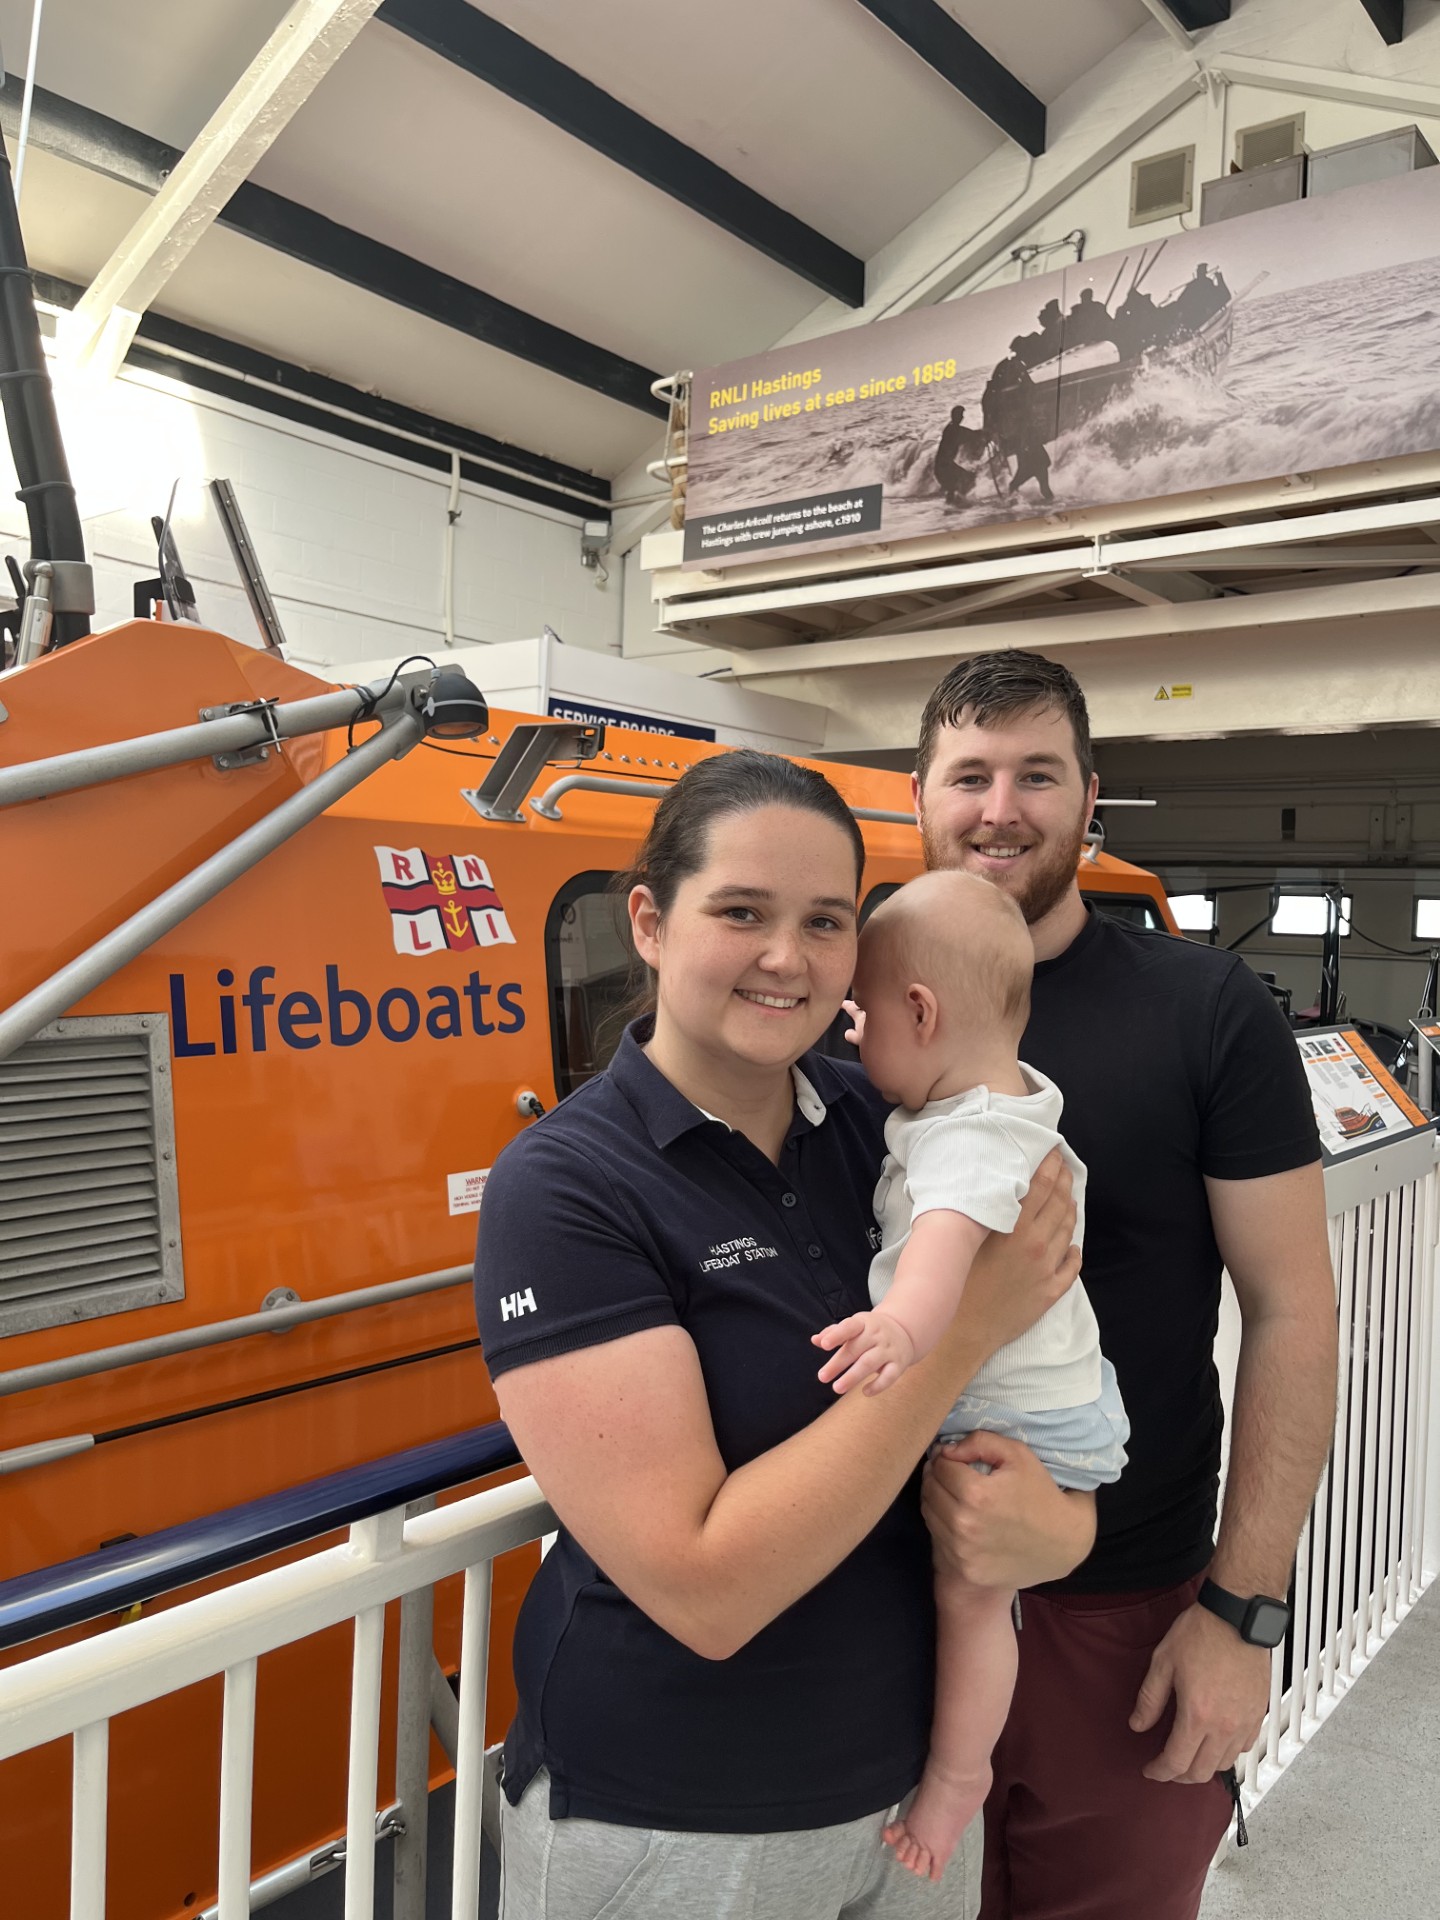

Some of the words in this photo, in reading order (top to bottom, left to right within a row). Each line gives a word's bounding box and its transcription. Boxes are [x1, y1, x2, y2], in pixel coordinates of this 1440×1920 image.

[708, 409, 759, 435] Saving
[763, 399, 801, 422] lives
[804, 393, 821, 413] at
[825, 387, 855, 407] sea
[859, 375, 907, 400] since
[912, 358, 957, 386] 1858
[709, 383, 747, 409] RNLI
[751, 367, 822, 399] Hastings
[701, 536, 734, 548] Hastings
[734, 531, 752, 543] with
[752, 530, 771, 540] crew
[771, 524, 804, 540] jumping
[804, 520, 834, 531] ashore,
[702, 524, 716, 535] The
[717, 520, 745, 532] Charles
[773, 511, 802, 523] returns
[802, 508, 812, 518] to
[813, 505, 827, 516] the
[827, 500, 853, 514] beach
[853, 498, 864, 509] at
[169, 964, 526, 1057] Lifeboats
[698, 1252, 740, 1273] LIFEBOAT
[744, 1246, 778, 1261] STATION
[708, 1236, 757, 1255] HASTINGS
[500, 1287, 538, 1321] HH
